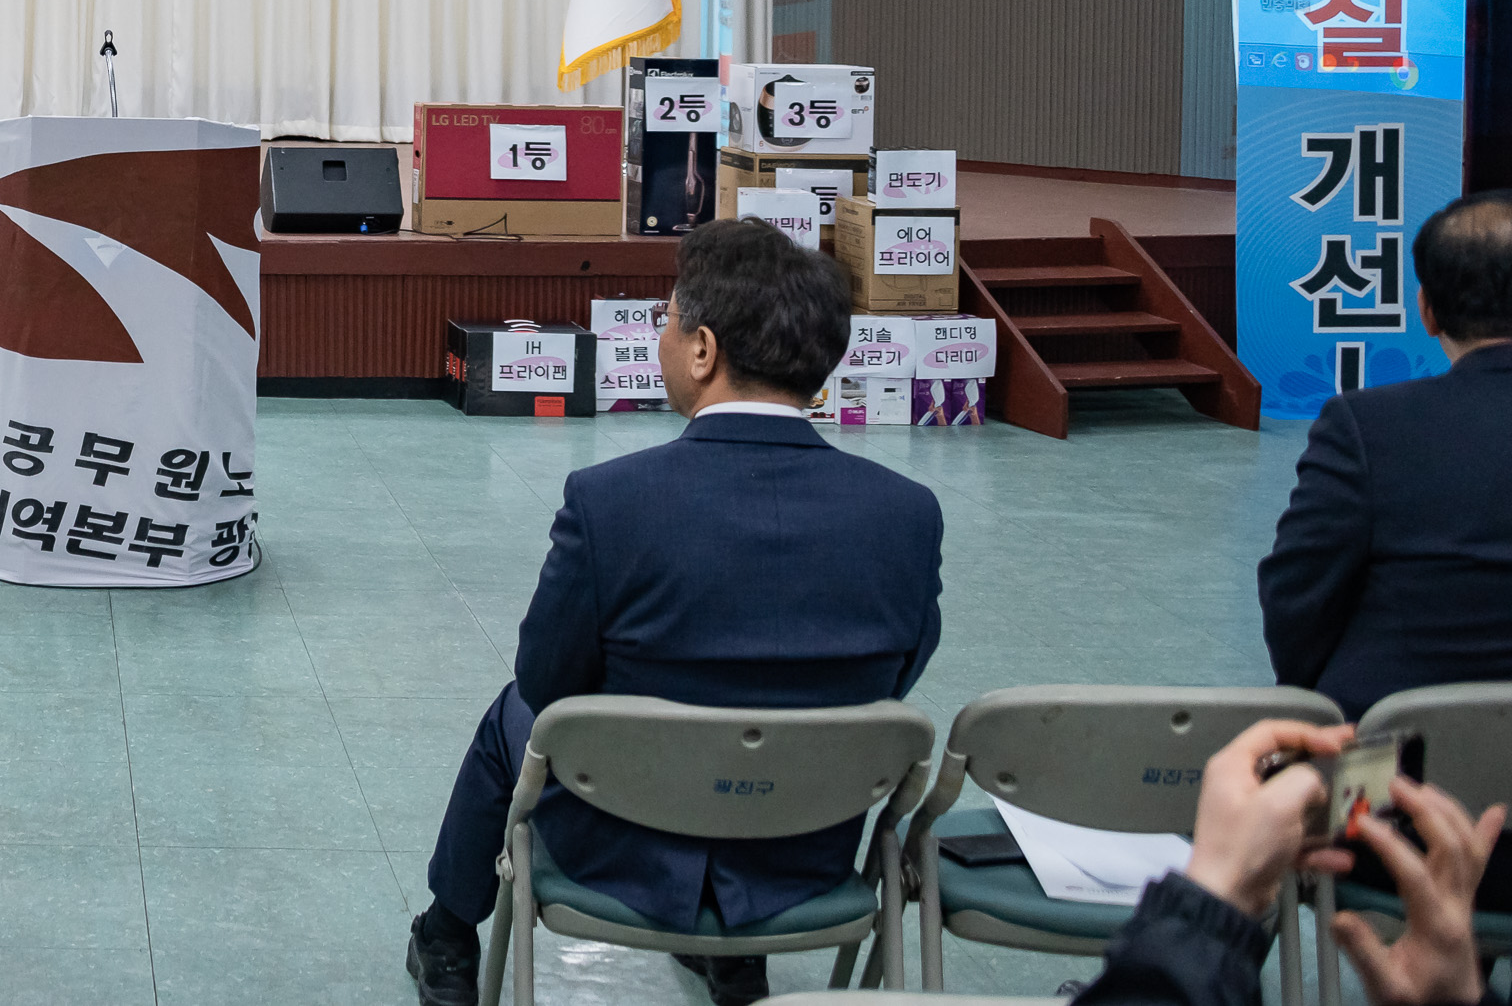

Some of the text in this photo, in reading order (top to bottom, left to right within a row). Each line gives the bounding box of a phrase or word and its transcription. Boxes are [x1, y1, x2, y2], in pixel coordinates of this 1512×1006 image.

[659, 94, 706, 123] 2등
[788, 100, 838, 129] 3등
[431, 115, 450, 126] LG
[453, 115, 479, 126] LED
[508, 141, 552, 171] 1등
[888, 171, 941, 188] 면도기
[896, 226, 932, 243] 에어
[878, 250, 950, 267] 프라이어
[614, 309, 647, 325] 헤어
[857, 327, 892, 343] 칫솔
[934, 326, 978, 341] 핸디형
[525, 340, 542, 355] IH
[848, 350, 902, 366] 살균기
[935, 349, 979, 364] 다리미
[498, 364, 567, 381] 프라이팬
[208, 512, 259, 568] 광
